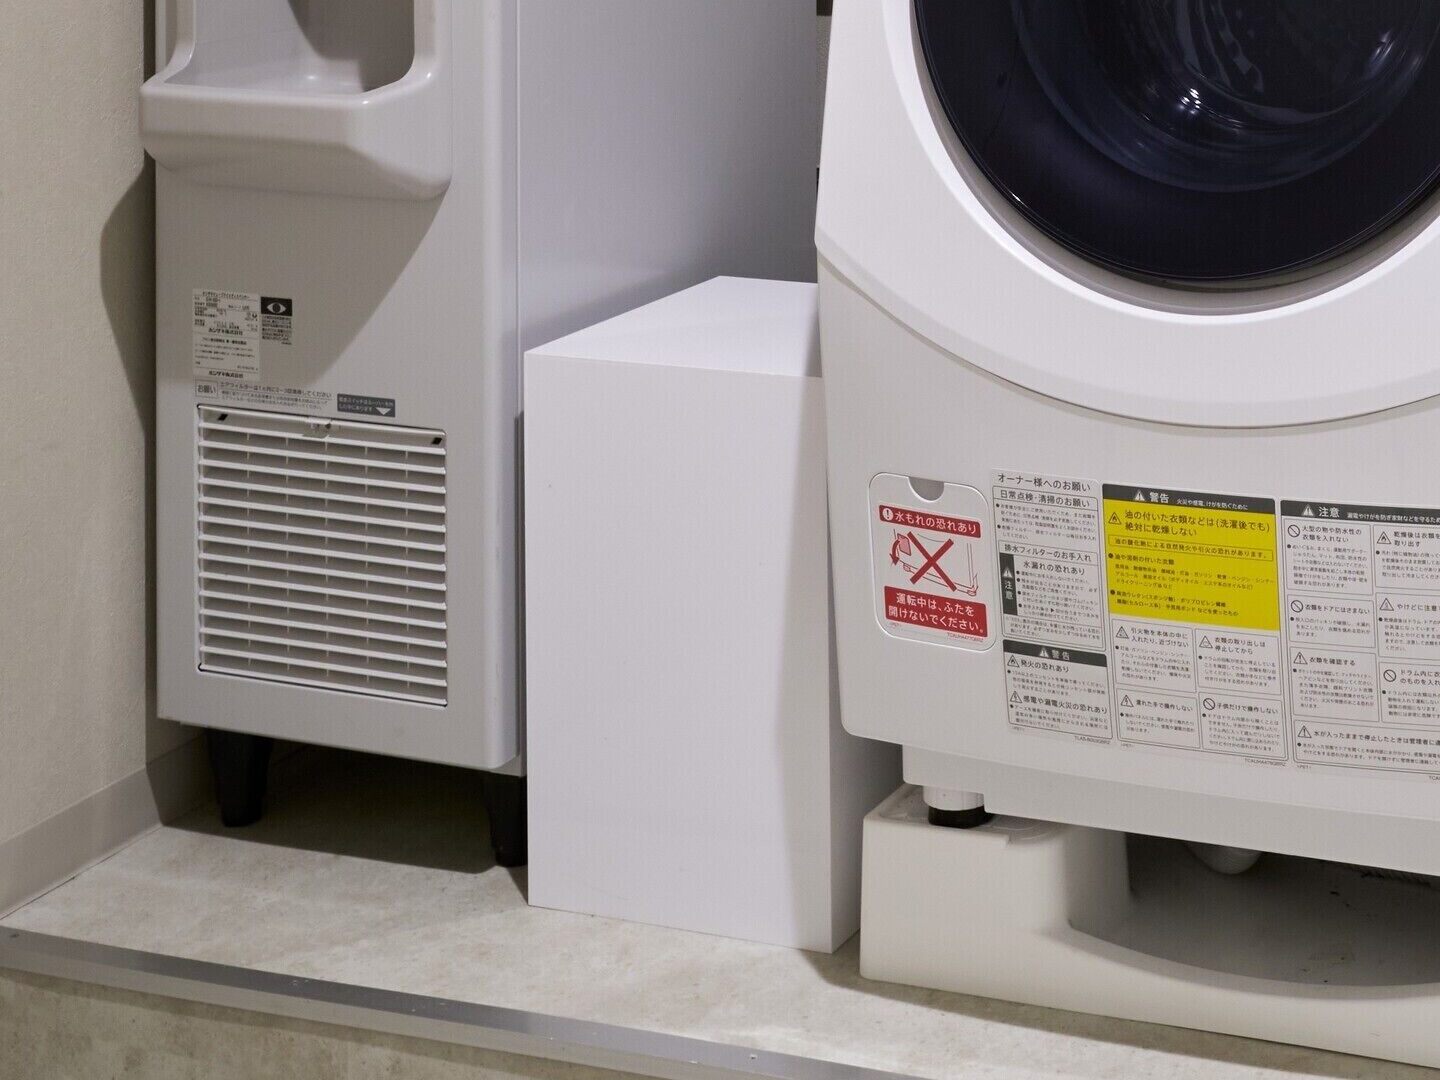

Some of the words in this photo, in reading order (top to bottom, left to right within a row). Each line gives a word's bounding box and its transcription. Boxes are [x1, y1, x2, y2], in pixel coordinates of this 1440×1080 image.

[1149, 492, 1170, 504] 警告
[1318, 506, 1340, 519] 注意
[894, 511, 977, 536] 水もれの恐れあり
[1125, 521, 1197, 537] 絶対に乾燥しない
[896, 592, 976, 617] 運転中は、ふたを
[888, 605, 984, 634] 開けないでください。
